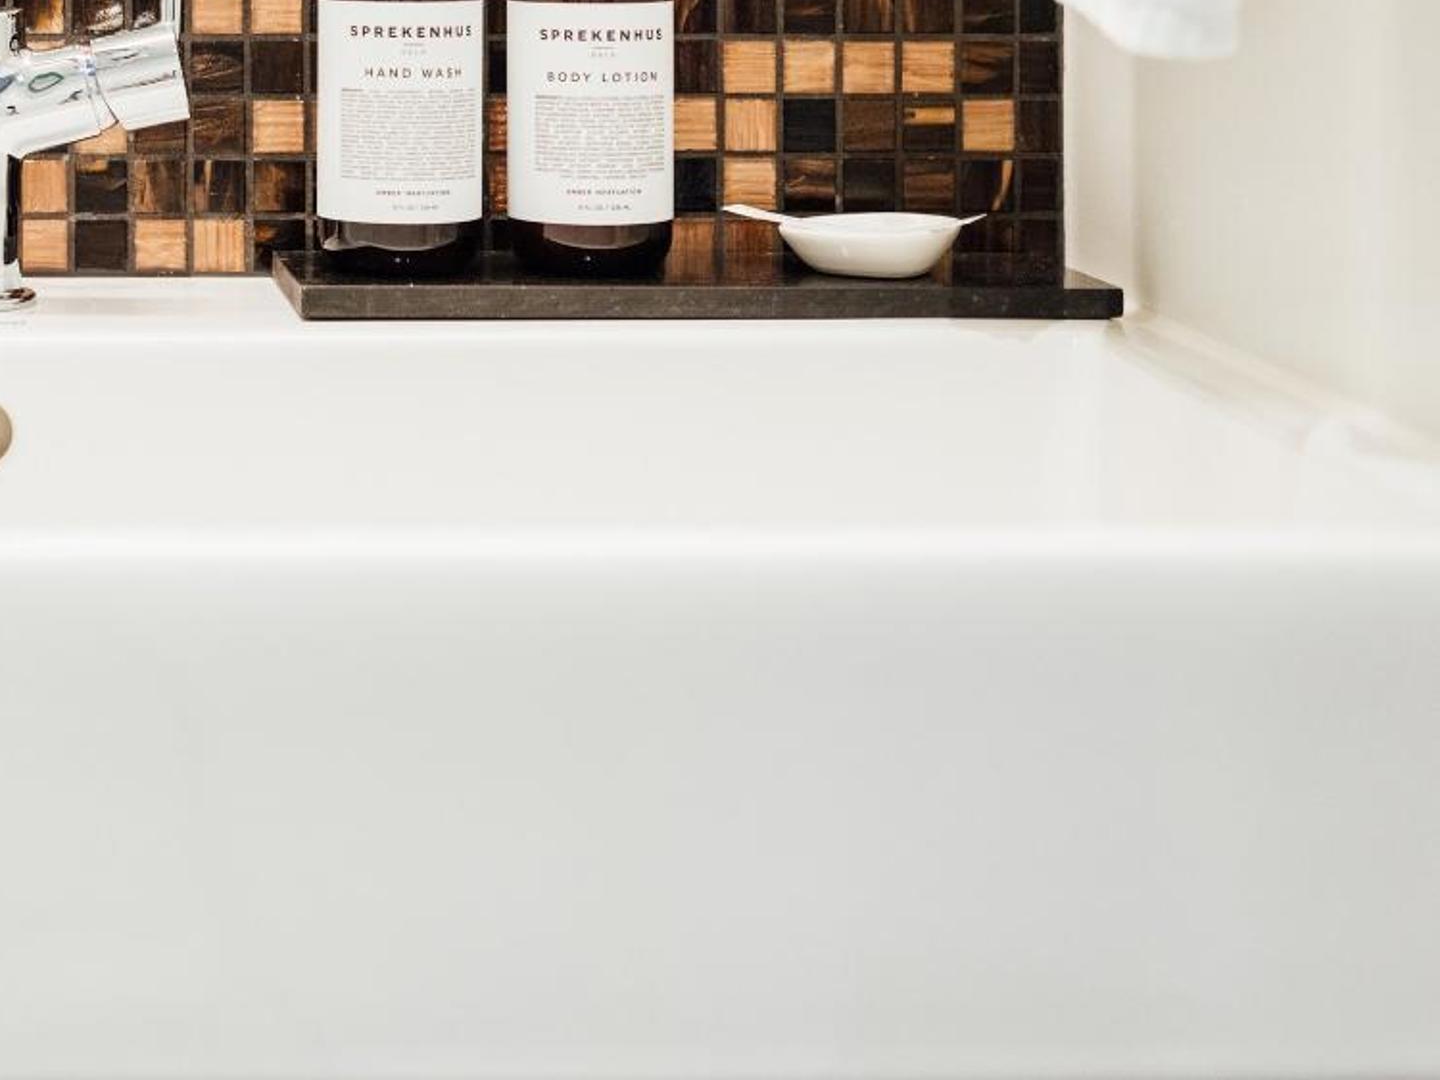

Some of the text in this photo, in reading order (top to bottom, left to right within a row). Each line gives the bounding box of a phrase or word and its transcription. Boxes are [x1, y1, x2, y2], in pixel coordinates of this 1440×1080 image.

[350, 25, 472, 38] SPREKENHUS
[539, 27, 664, 42] SPREKENHUS
[364, 66, 463, 79] HAND WASH
[546, 71, 658, 83] BODY LOTION
